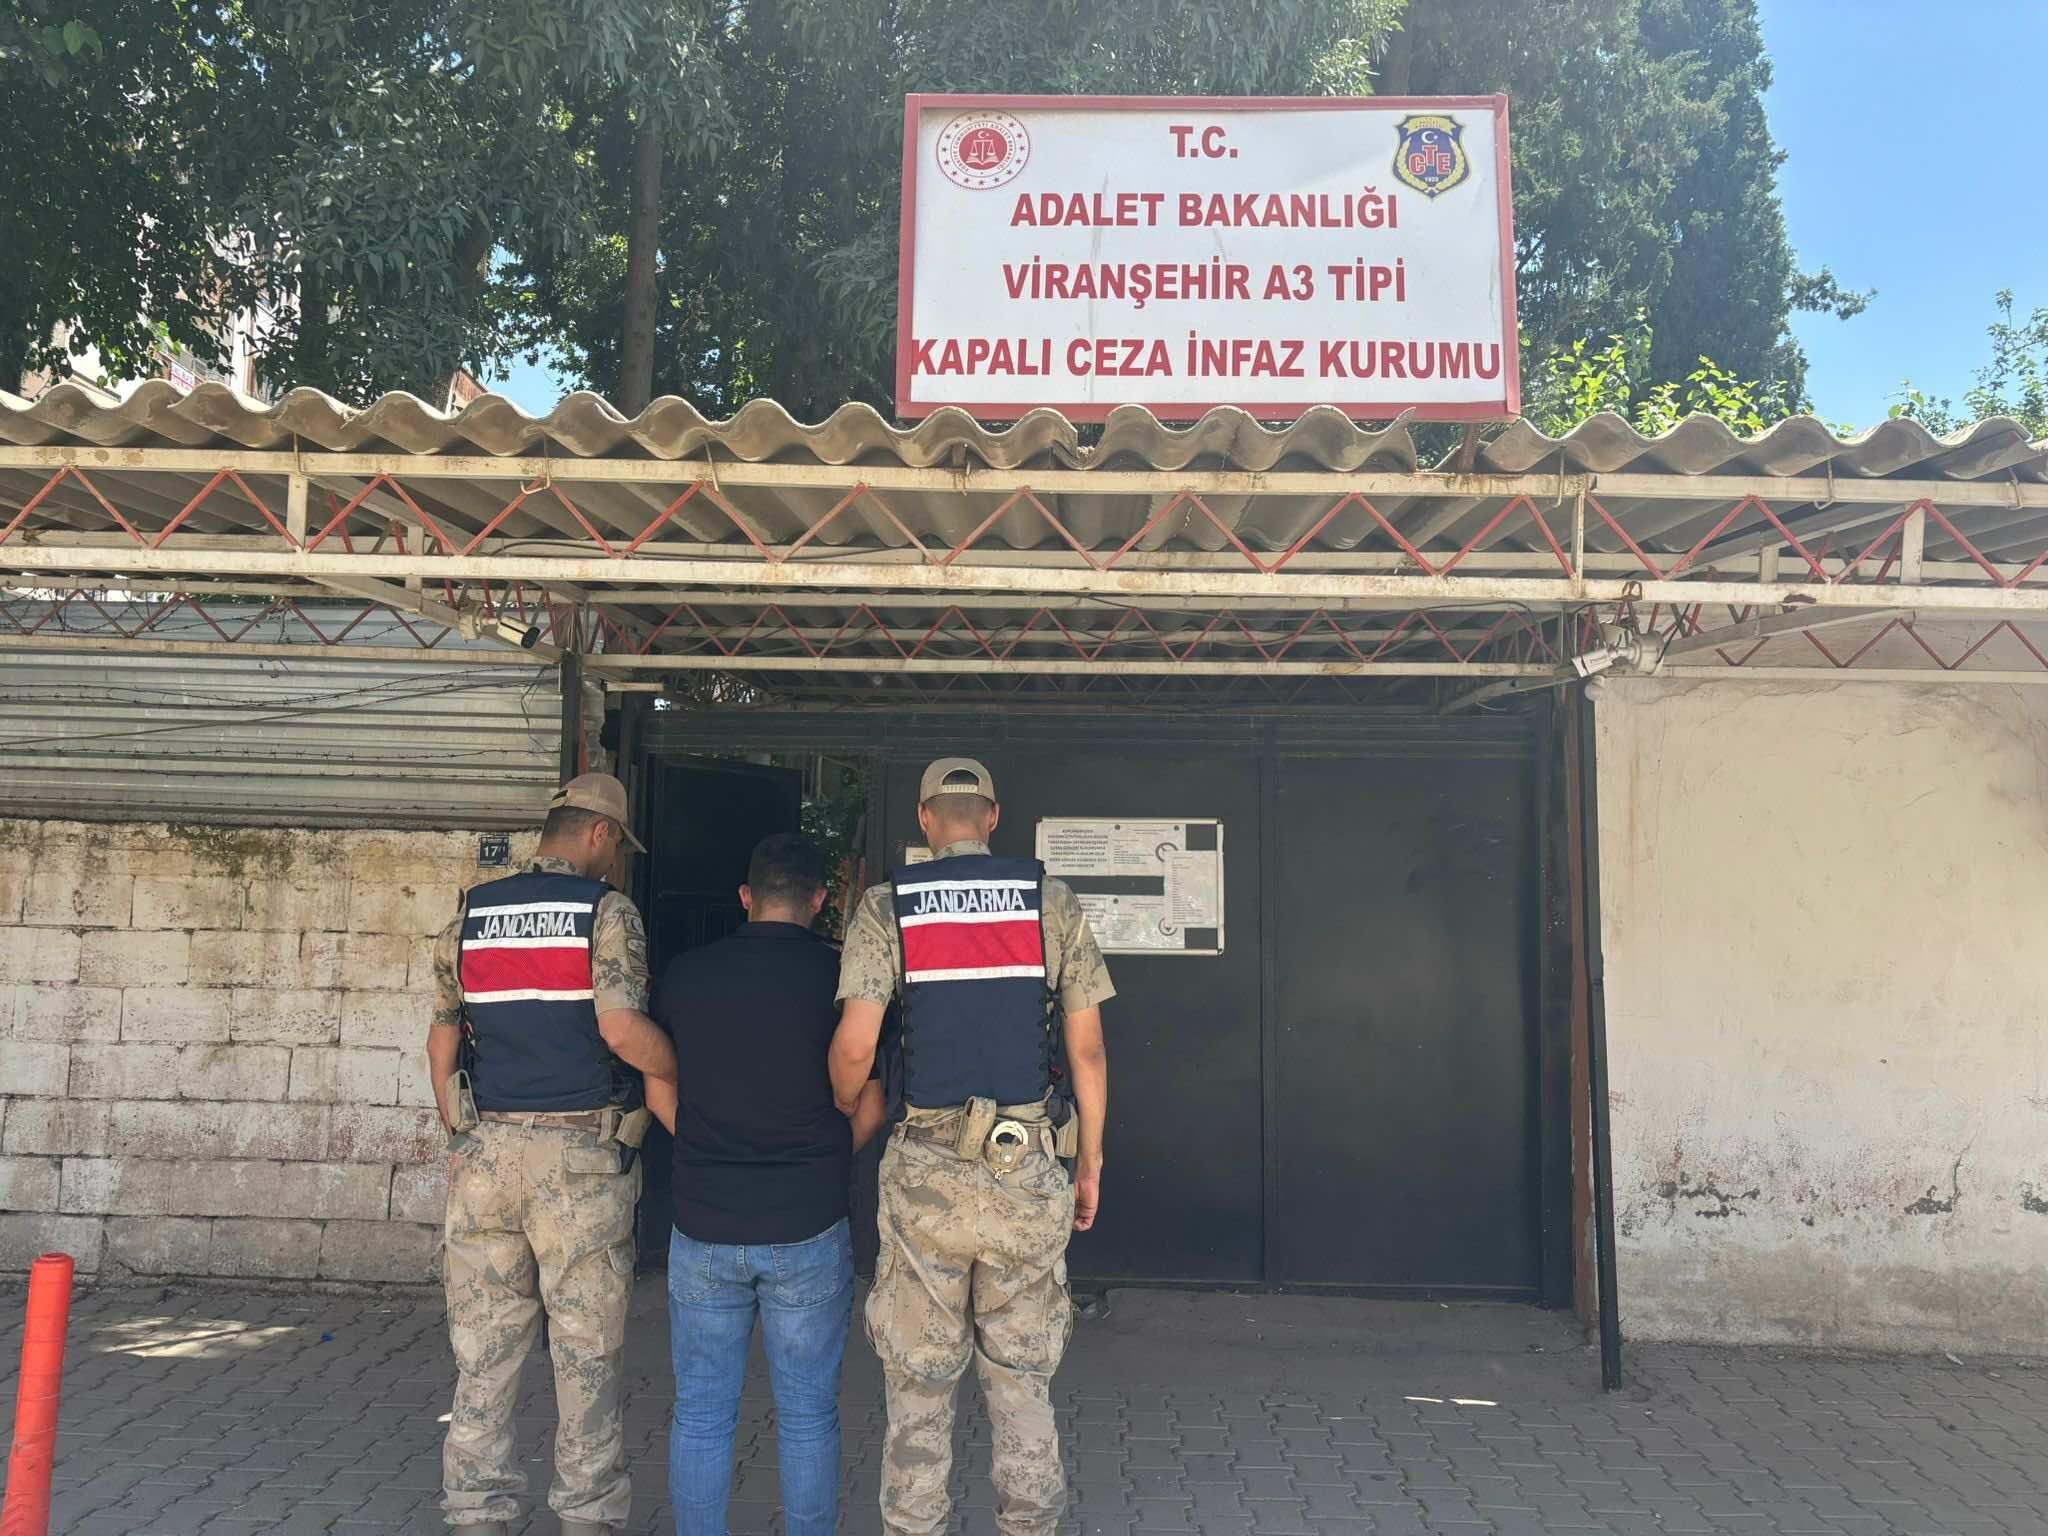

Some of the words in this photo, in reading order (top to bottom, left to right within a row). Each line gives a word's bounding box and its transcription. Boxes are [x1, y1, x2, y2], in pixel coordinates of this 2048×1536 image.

[1169, 126, 1238, 158] T.C.
[1011, 193, 1164, 227] ADALET
[1179, 187, 1398, 229] BAKANLIĞI
[1003, 255, 1250, 309] VİRANŞEHİR
[1264, 265, 1313, 301] A3
[1328, 258, 1405, 302] TİPİ
[911, 339, 1052, 376] KAPALI
[1066, 339, 1173, 377] CEZA
[1187, 331, 1304, 378] İNFAZ
[1319, 341, 1500, 380] KURUMU
[913, 888, 1026, 914] JANDARMA
[478, 912, 576, 939] JANDARMA
